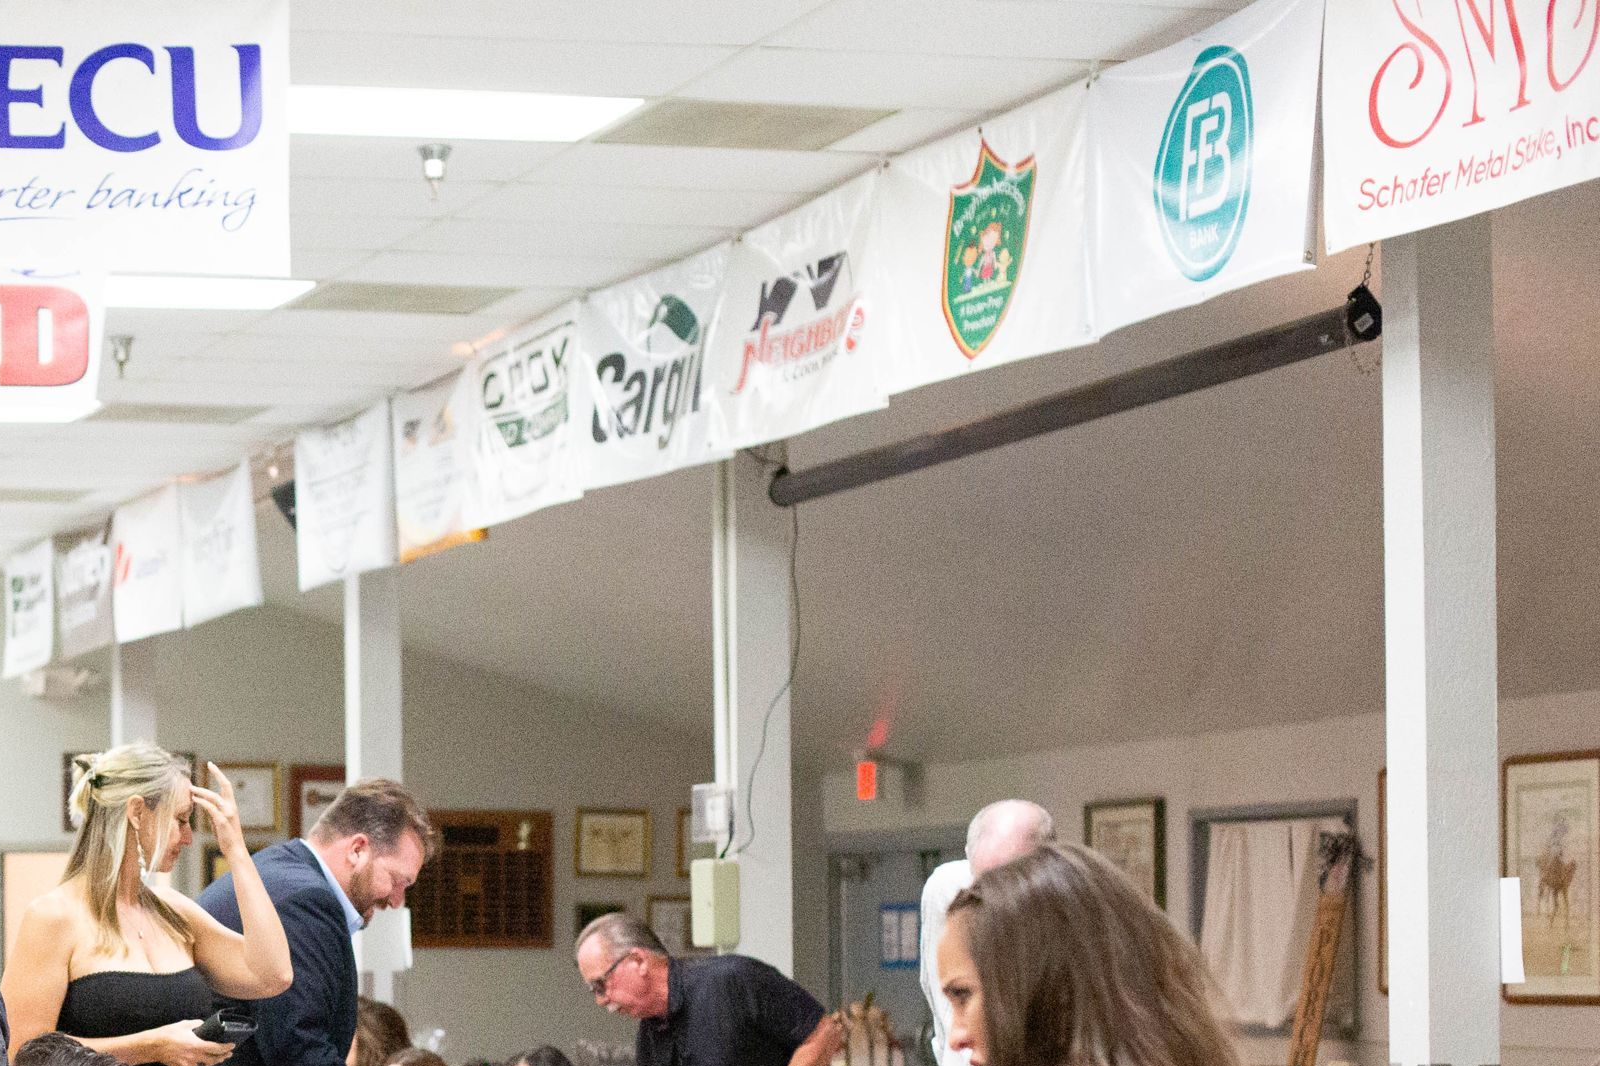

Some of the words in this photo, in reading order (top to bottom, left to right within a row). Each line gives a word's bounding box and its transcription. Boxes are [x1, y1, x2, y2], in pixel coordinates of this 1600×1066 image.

[86, 168, 258, 232] banking
[1358, 167, 1450, 210] Schafer
[1455, 144, 1510, 191] Metal
